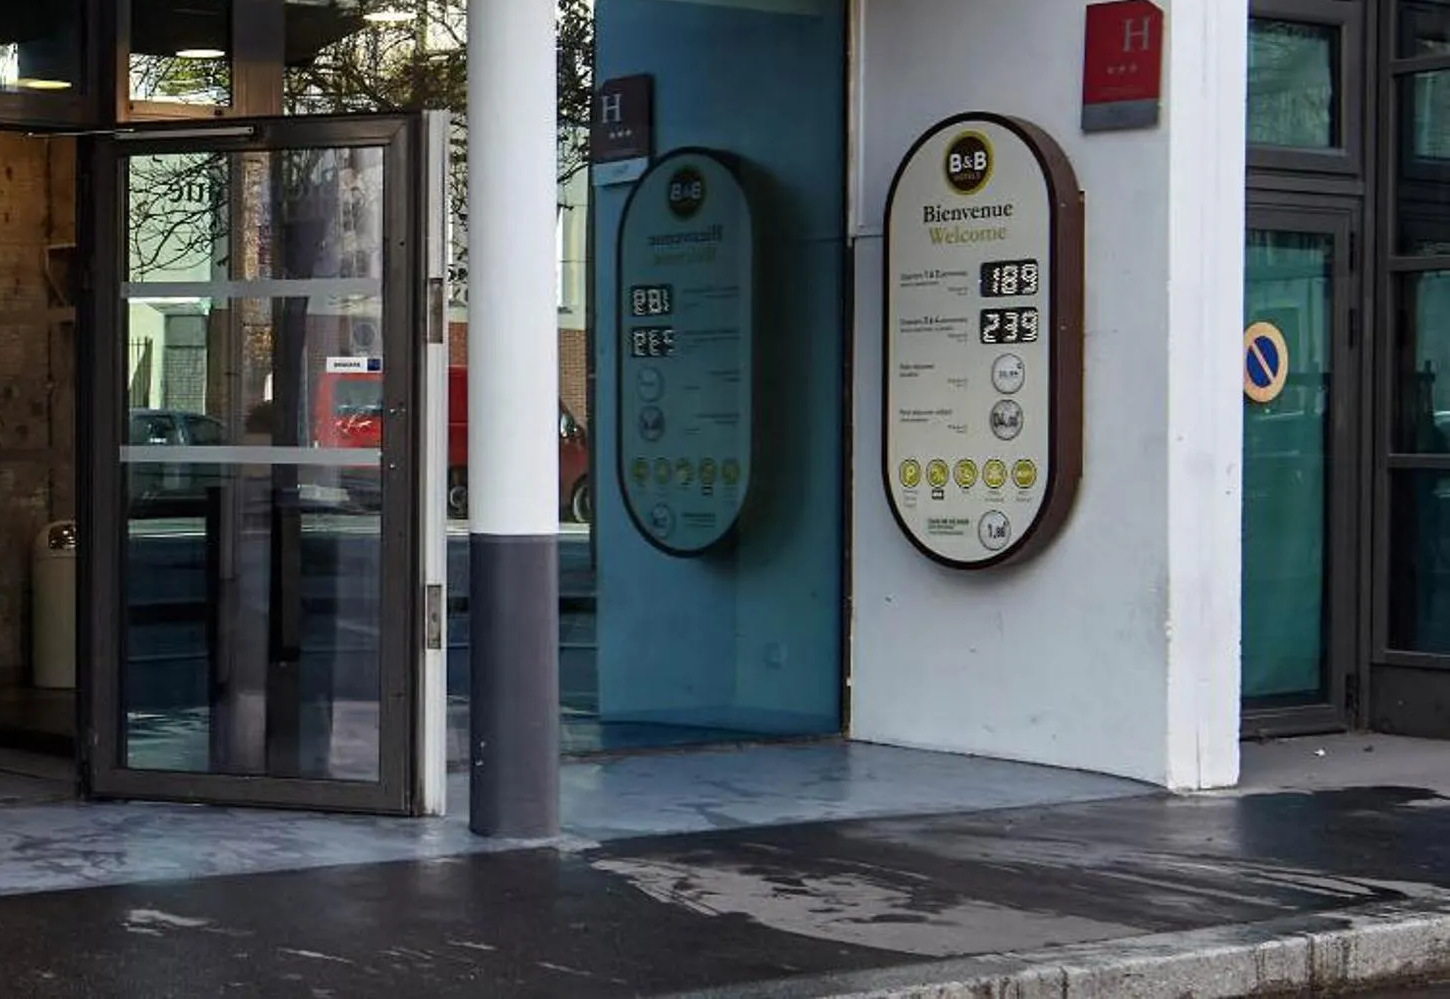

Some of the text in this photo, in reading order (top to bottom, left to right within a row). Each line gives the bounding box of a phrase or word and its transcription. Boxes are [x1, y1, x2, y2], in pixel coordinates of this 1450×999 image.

[1121, 15, 1150, 53] H
[949, 151, 988, 173] B&B
[923, 202, 1014, 224] Bienvenue
[929, 225, 1007, 245] Welcome
[992, 263, 1038, 294] 189
[983, 310, 1039, 343] 239
